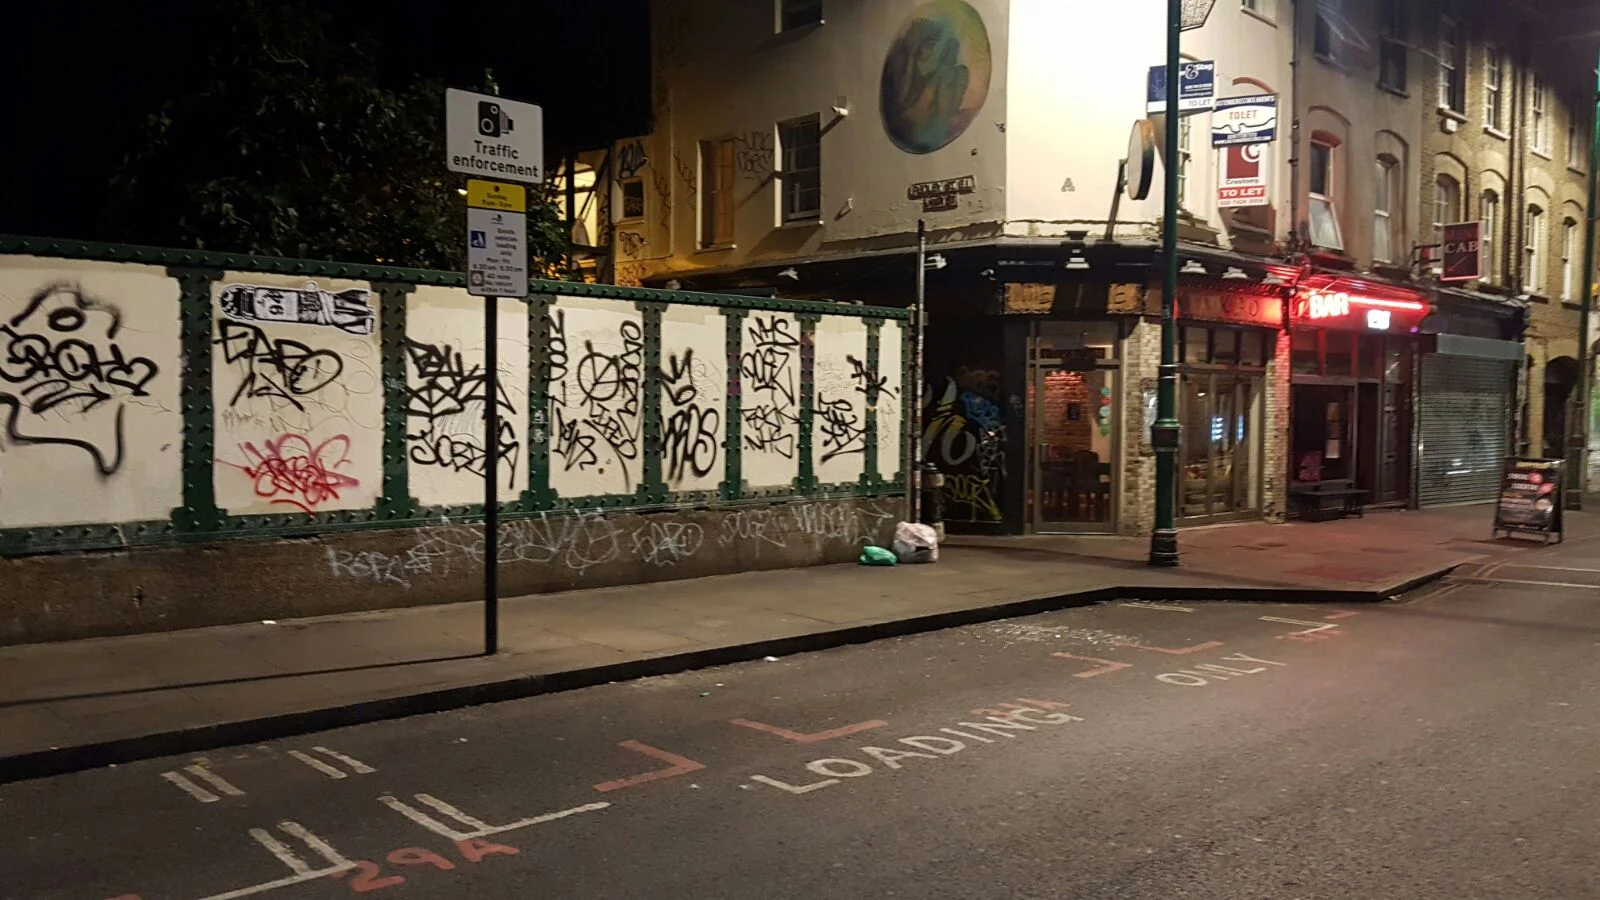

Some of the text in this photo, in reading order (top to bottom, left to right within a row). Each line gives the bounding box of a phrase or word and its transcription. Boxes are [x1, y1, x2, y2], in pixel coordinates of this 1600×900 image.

[473, 139, 519, 160] Traffic
[453, 154, 539, 178] enforcement
[1220, 187, 1264, 198] TO LET
[1444, 240, 1479, 254] CAB
[1309, 292, 1350, 319] BAR
[749, 707, 1085, 794] LOADING
